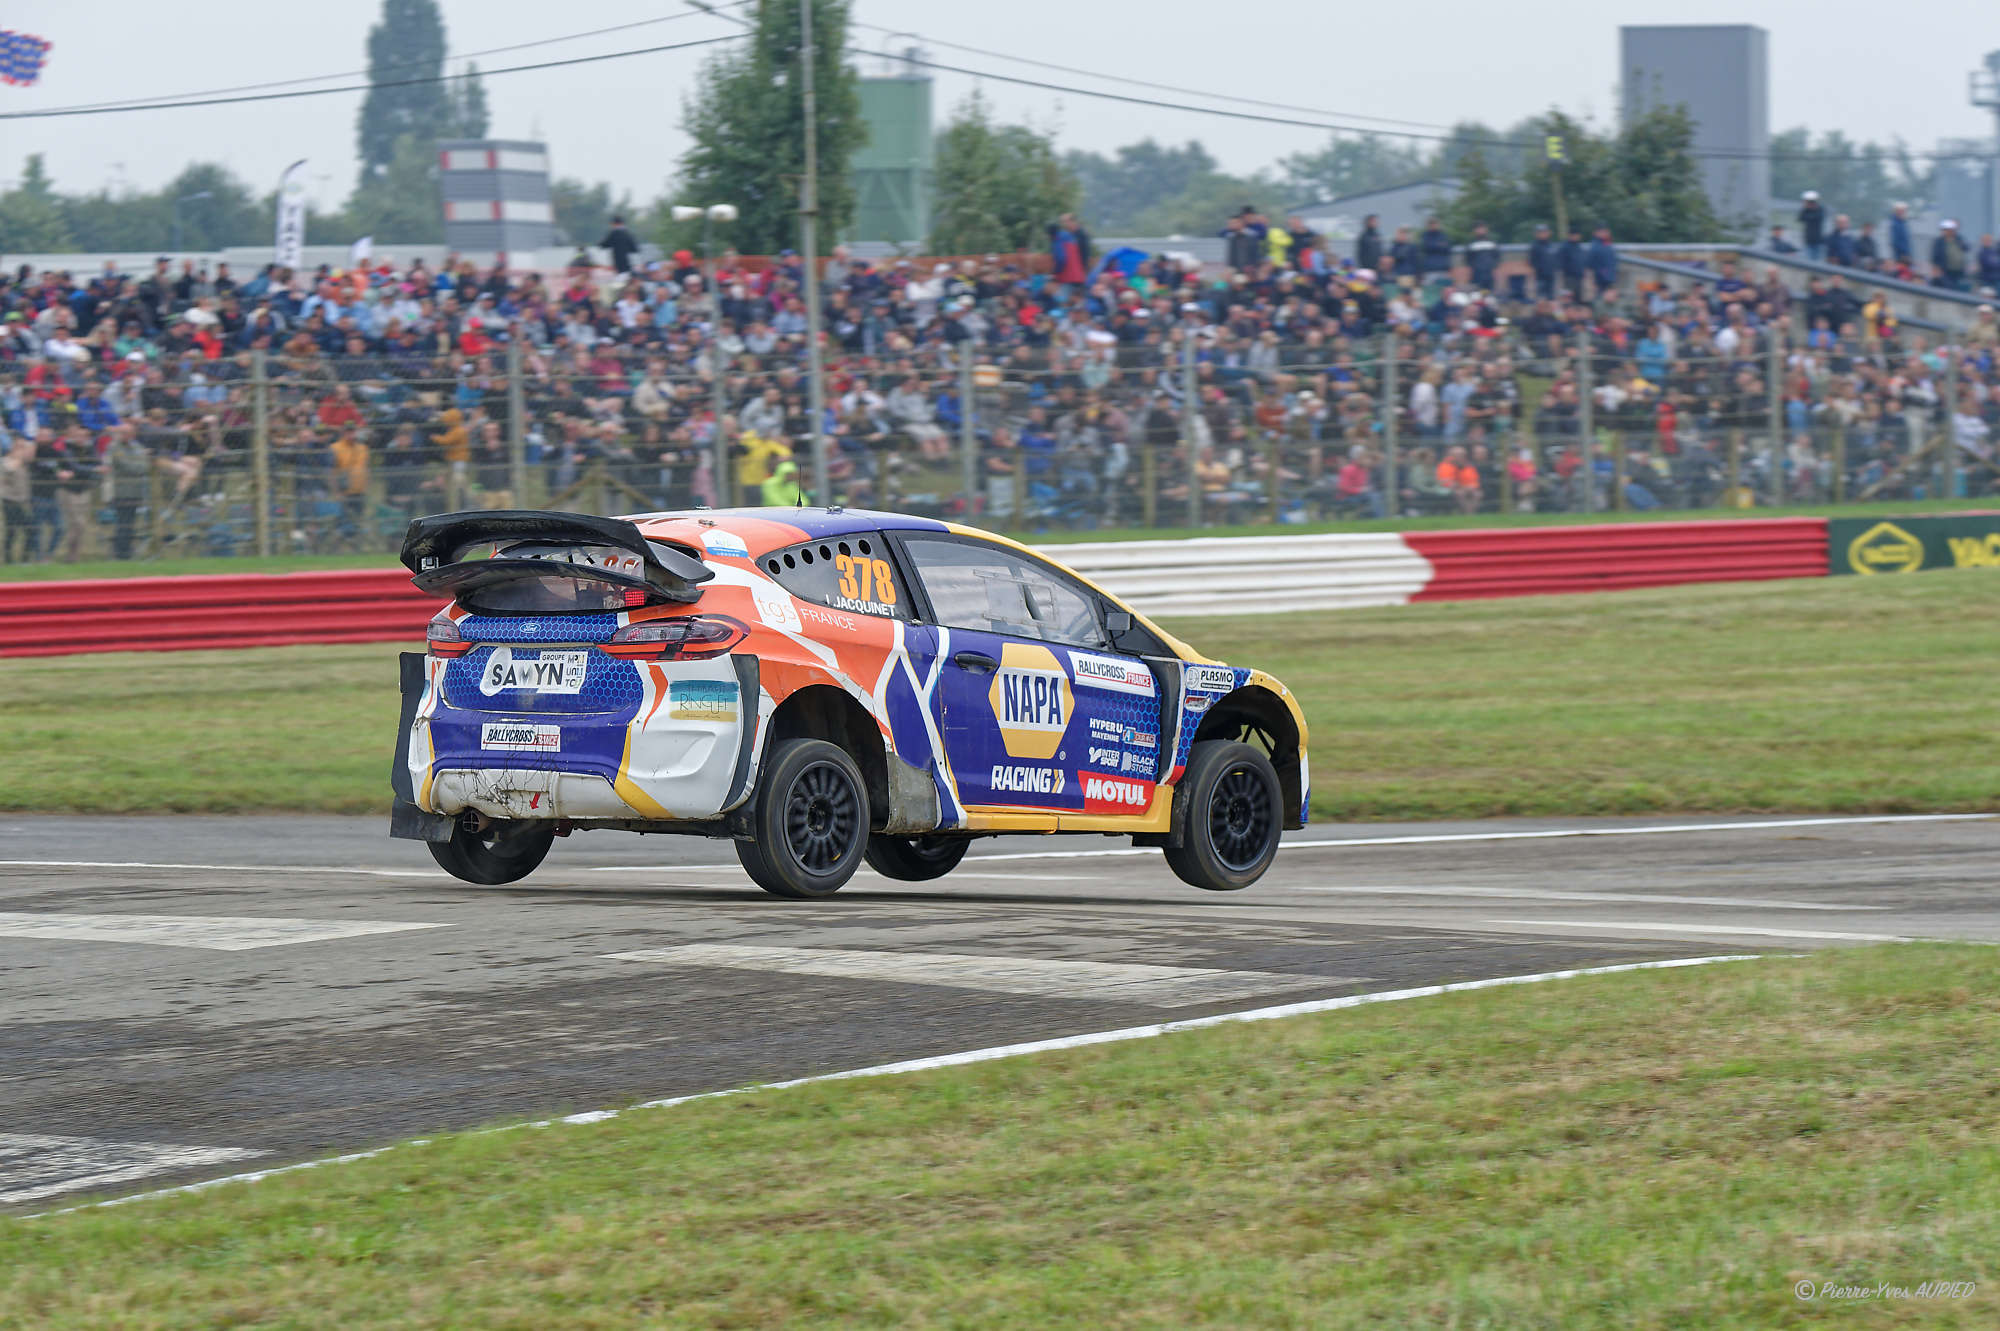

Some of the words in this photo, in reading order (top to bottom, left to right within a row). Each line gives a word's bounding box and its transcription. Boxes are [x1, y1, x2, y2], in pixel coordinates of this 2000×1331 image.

[835, 553, 897, 605] 378
[800, 607, 857, 632] FRANCE
[1078, 659, 1126, 681] RALLYCROSS
[1127, 672, 1151, 688] FRANCE
[1200, 670, 1233, 683] PLASMO
[1003, 673, 1062, 725] NAPA
[1089, 717, 1116, 733] HYPER
[486, 728, 535, 743] RALLYCROSS
[1091, 730, 1120, 743] MAYENNE
[1131, 763, 1154, 775] STORE
[1132, 754, 1155, 767] BLACK
[991, 765, 1052, 793] RACING
[1085, 778, 1147, 806] MOTUL
